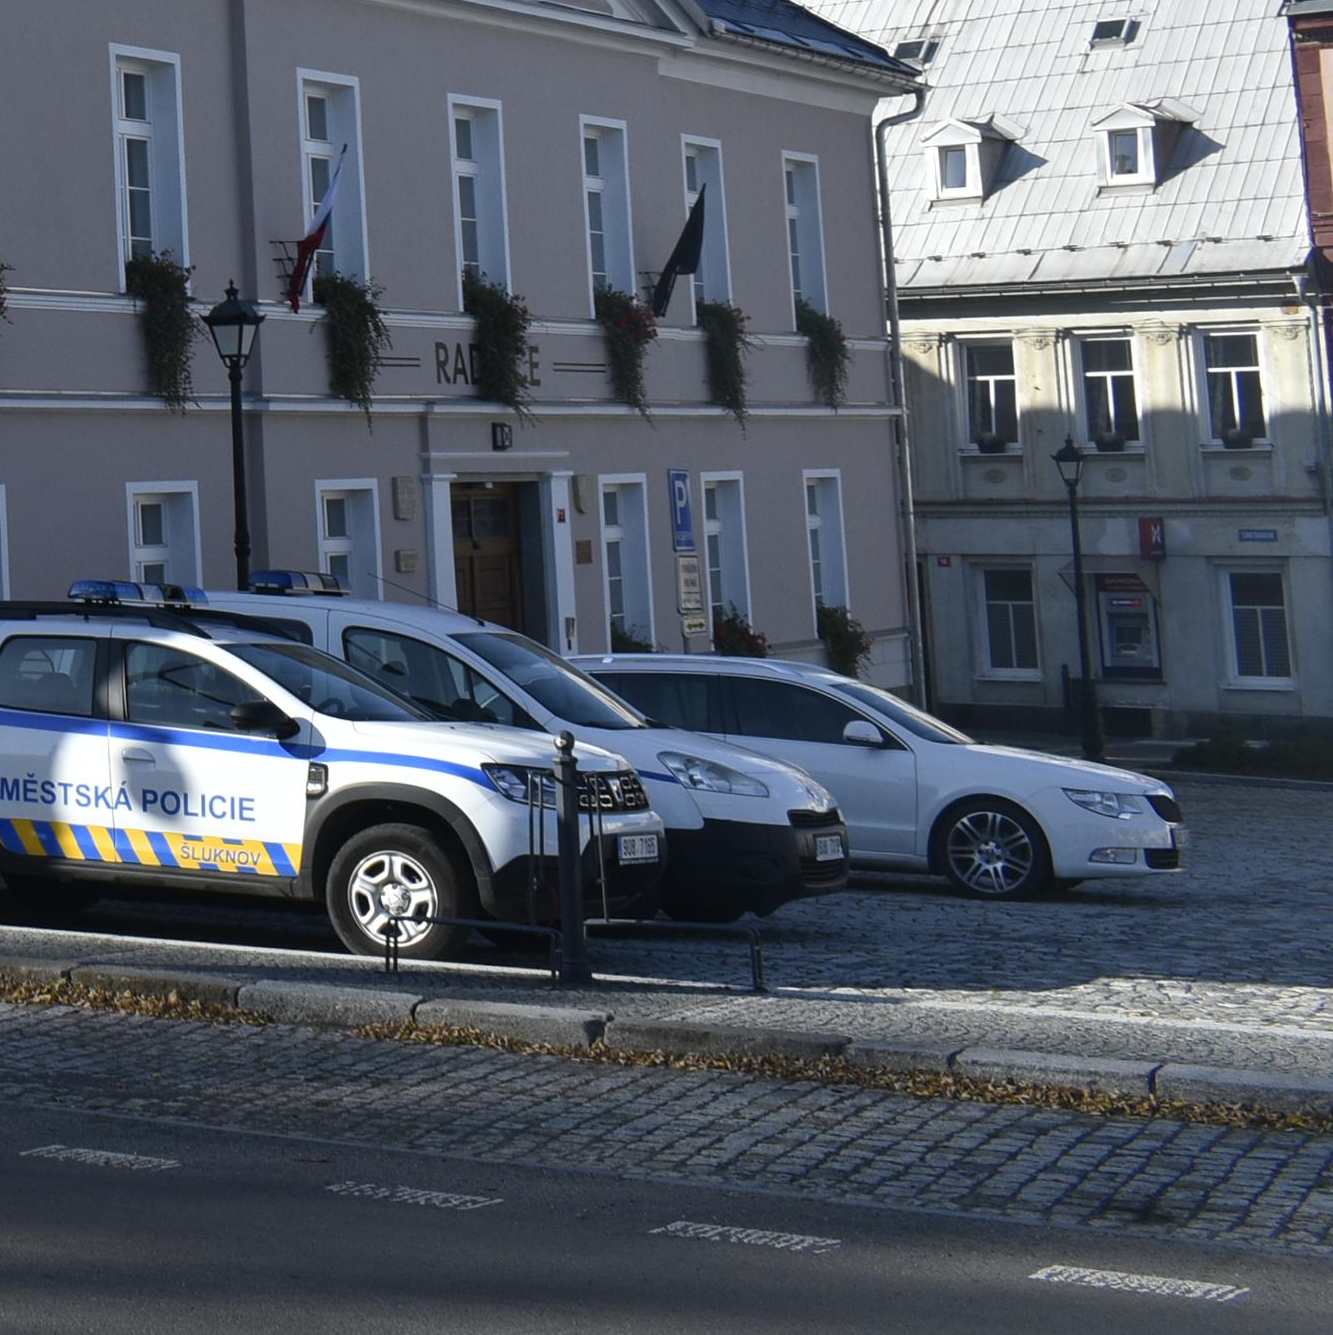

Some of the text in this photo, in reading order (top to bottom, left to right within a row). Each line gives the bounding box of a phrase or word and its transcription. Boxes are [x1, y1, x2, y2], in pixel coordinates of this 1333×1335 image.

[434, 341, 541, 387] RADE
[674, 479, 687, 525] P
[0, 772, 256, 822] MĚSTSKÁ POLICIE
[180, 841, 261, 866] ŠLUKNOV
